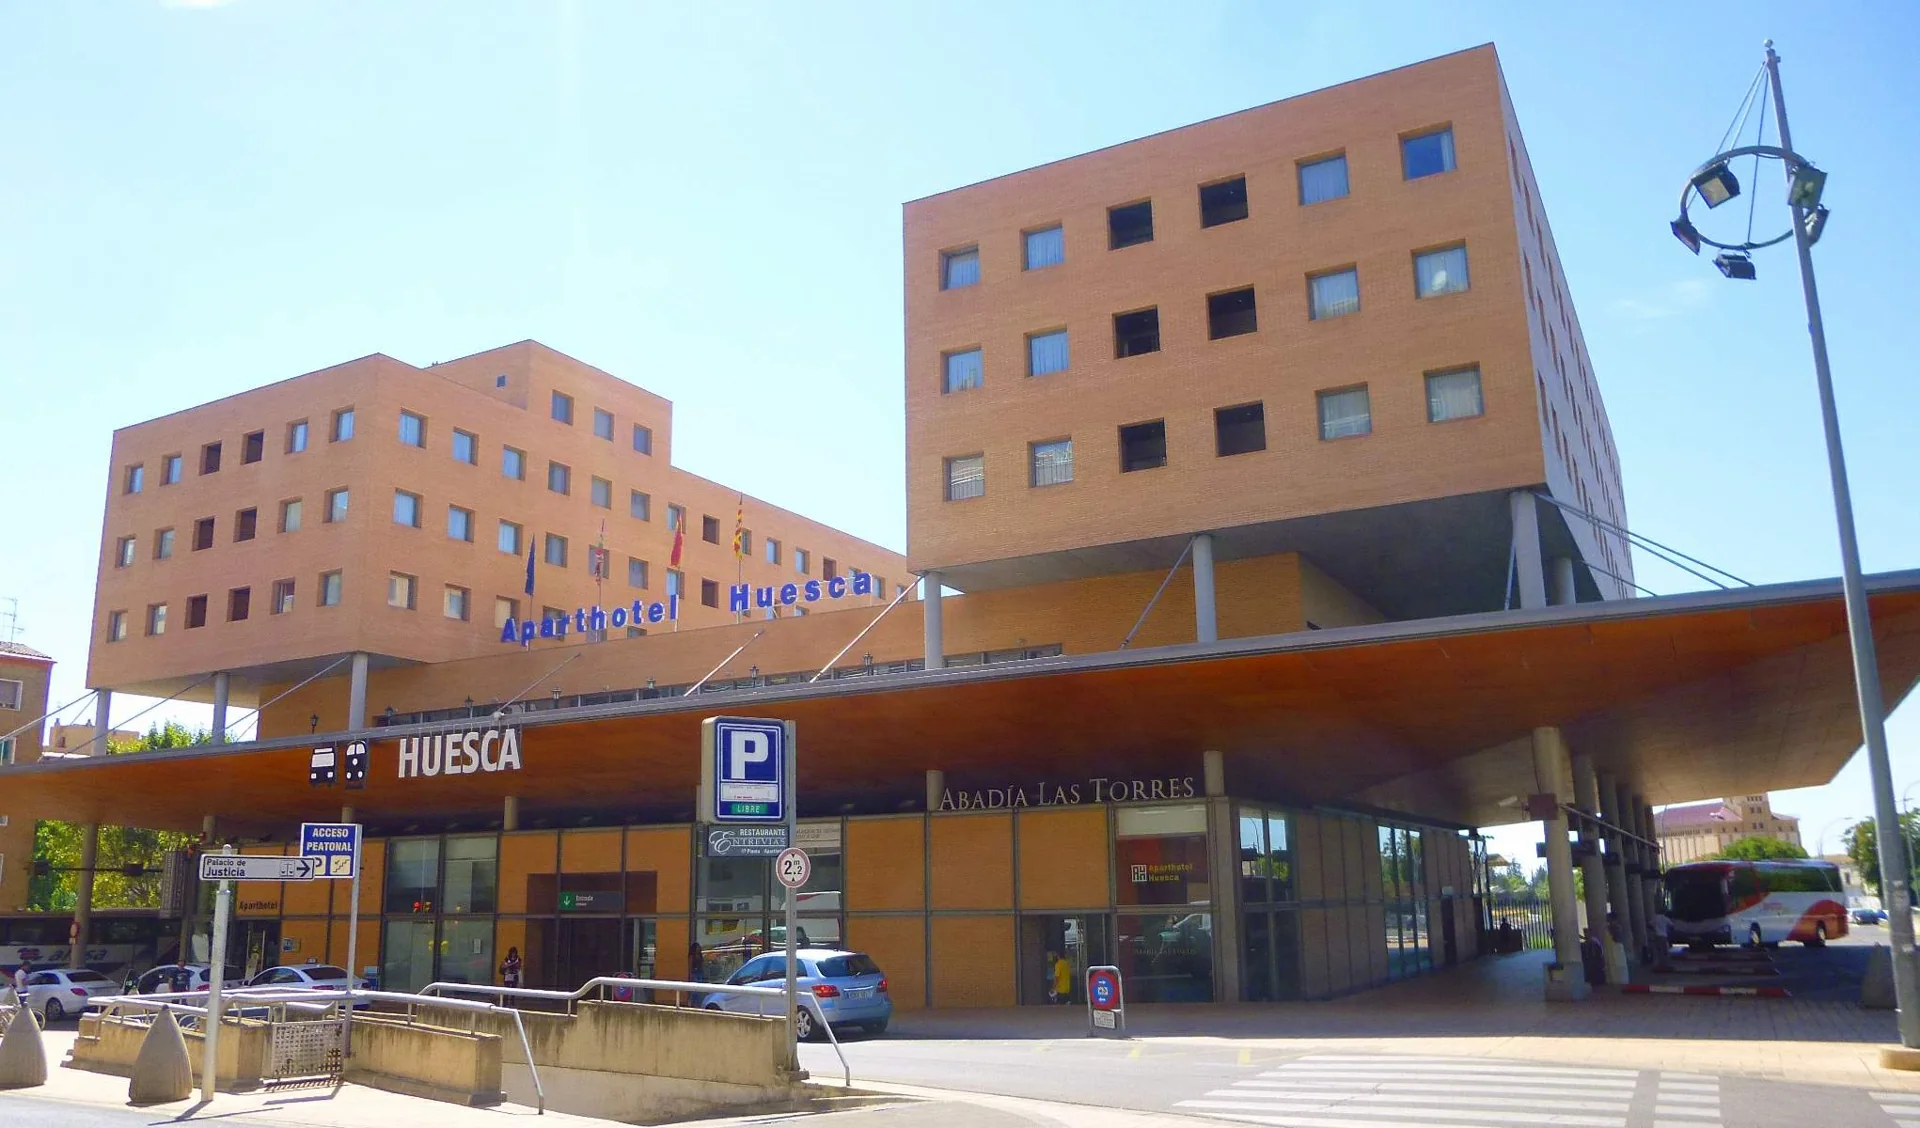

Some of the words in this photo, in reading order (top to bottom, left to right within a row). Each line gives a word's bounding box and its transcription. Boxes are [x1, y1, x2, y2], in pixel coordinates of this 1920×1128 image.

[501, 594, 678, 647] Aparthotel
[730, 572, 873, 612] Huesca
[398, 728, 521, 778] HUESCA
[731, 731, 769, 779] P
[1038, 782, 1080, 806] LAS
[1089, 777, 1195, 803] TORRES
[737, 804, 761, 814] LIBRE
[312, 828, 349, 838] ACCESO
[740, 828, 786, 837] RESTAURANTE
[306, 841, 353, 852] PEATONAL
[206, 858, 235, 867] Palacio
[237, 859, 247, 867] de
[1148, 863, 1193, 873] Aparthotel
[206, 867, 246, 878] Justicia
[239, 901, 277, 912] Aparthotel
